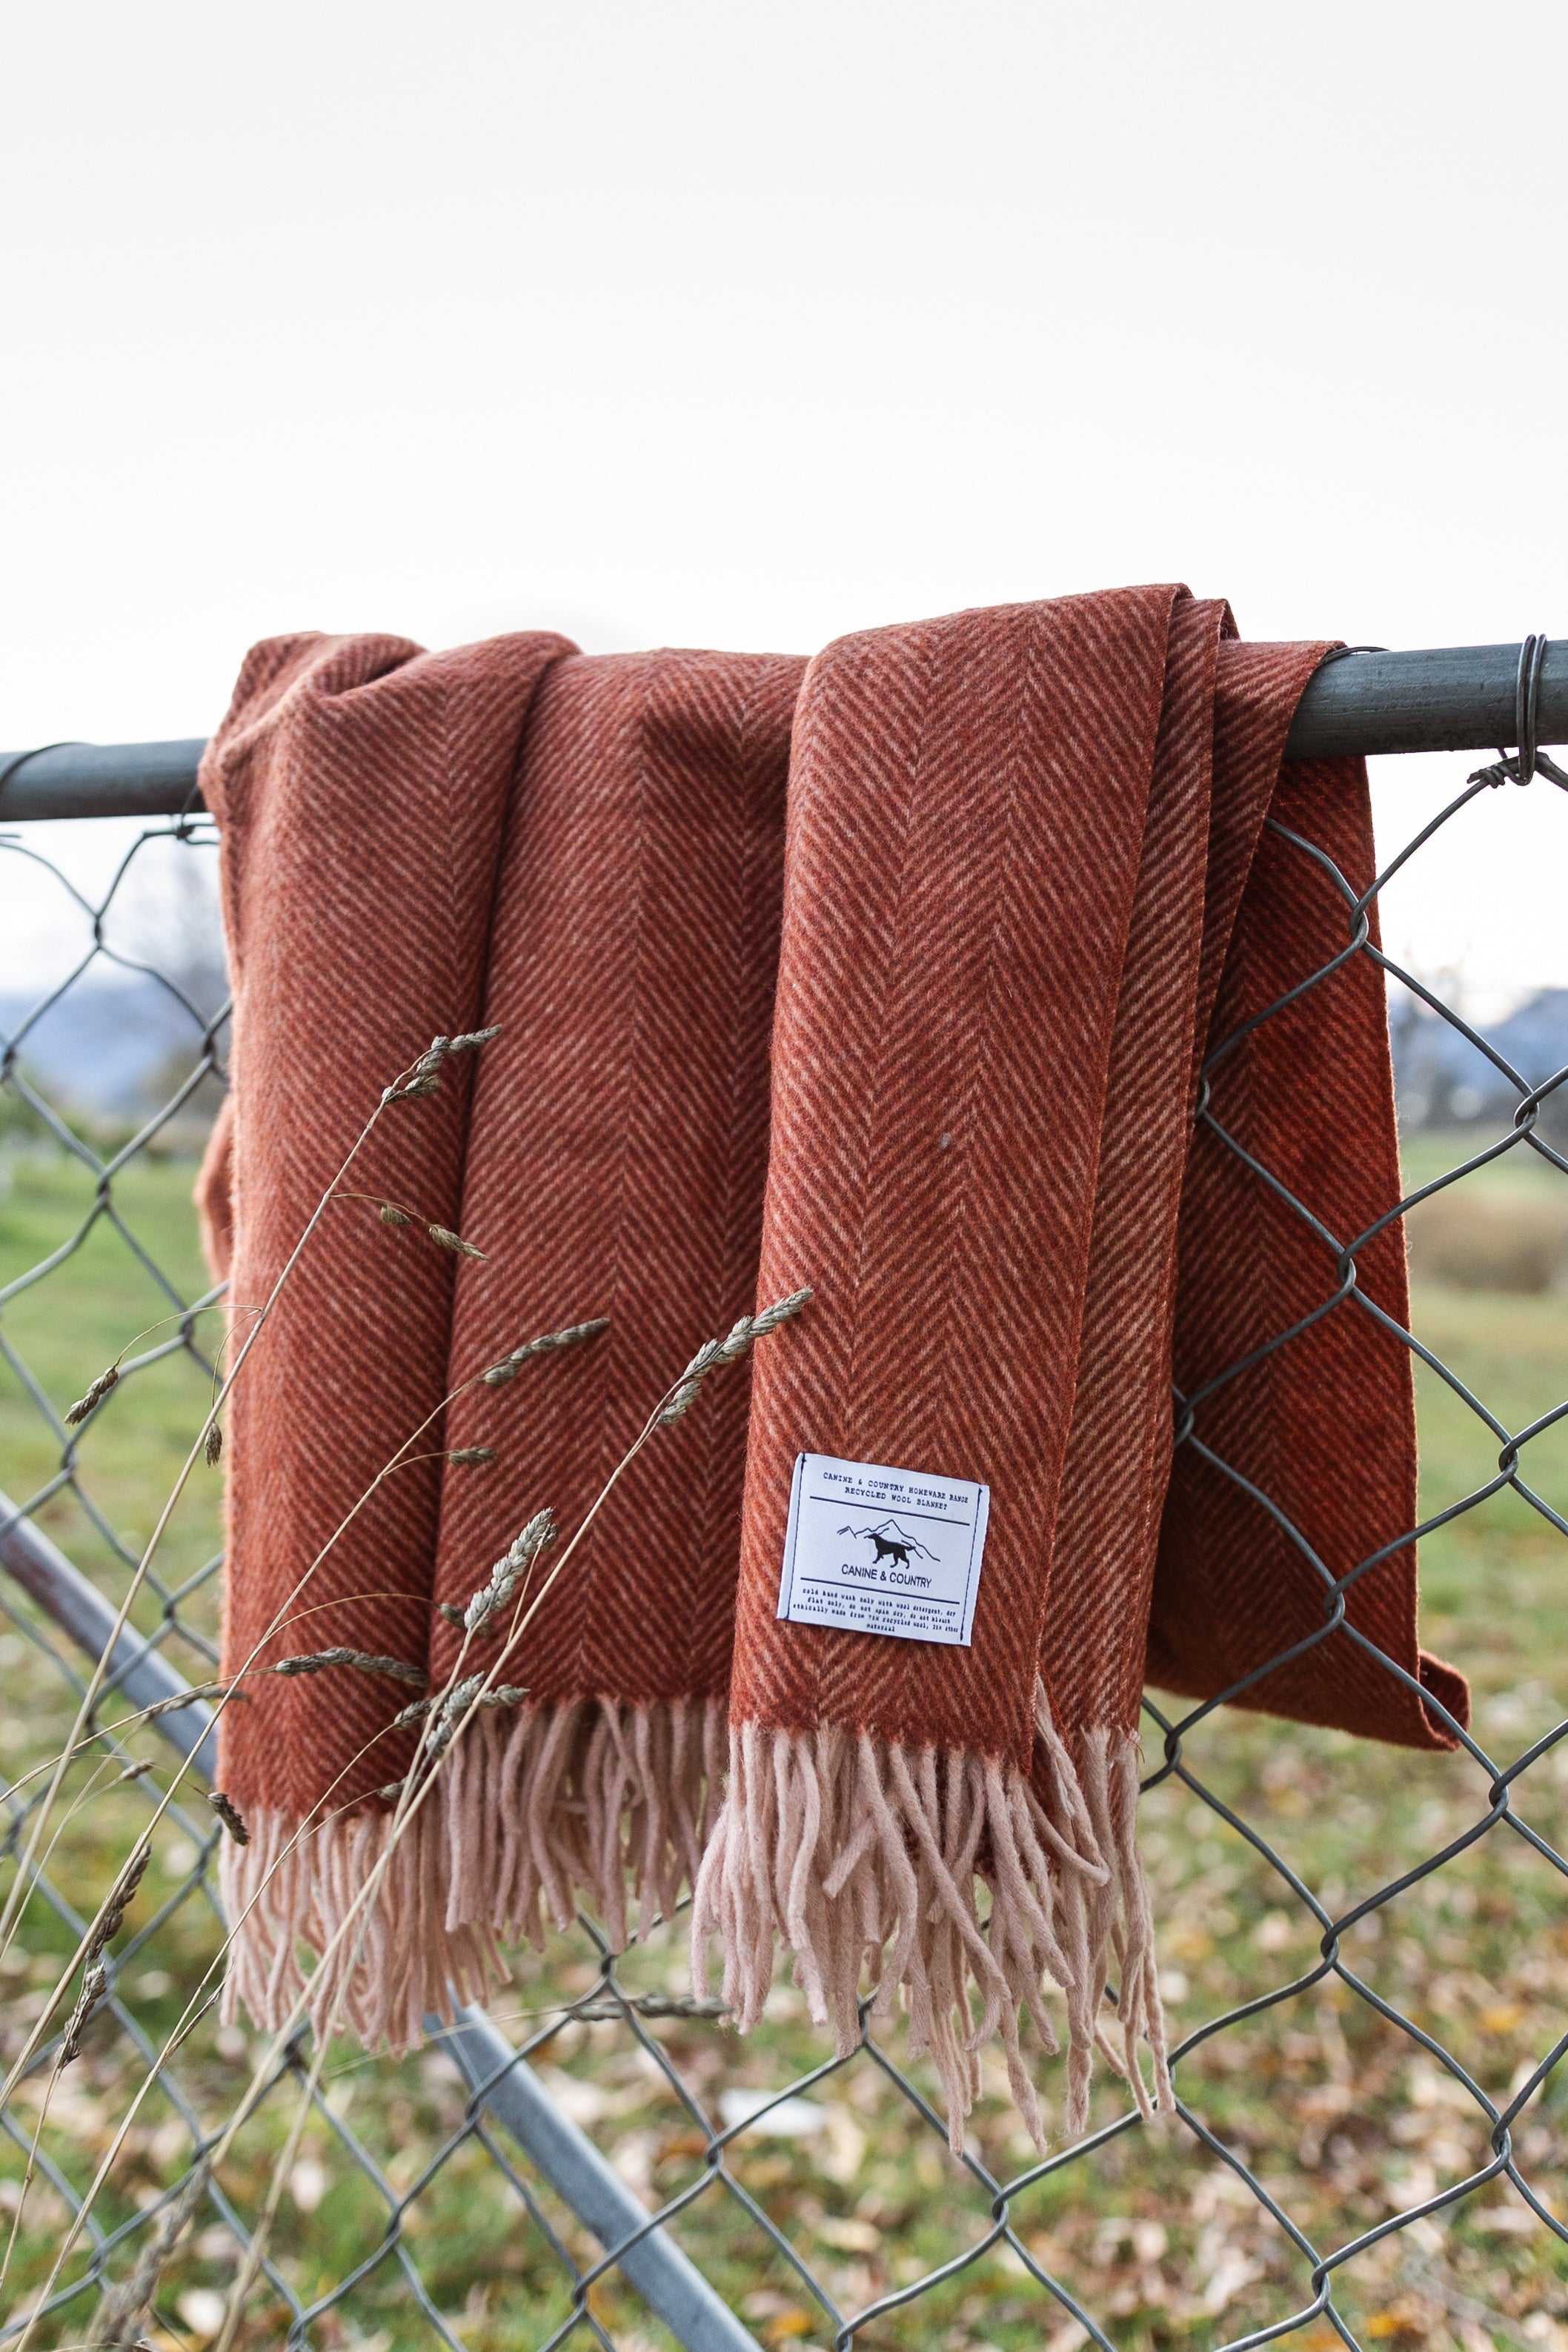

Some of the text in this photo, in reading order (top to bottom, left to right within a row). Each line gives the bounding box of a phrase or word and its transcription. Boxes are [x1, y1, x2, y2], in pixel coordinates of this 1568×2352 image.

[823, 1472, 853, 1484] CANINE
[868, 1480, 904, 1492] COUNTRY
[908, 1486, 946, 1499] HOMEWARE
[949, 1494, 969, 1504] RANGE
[845, 1486, 948, 1510] RECYCLED WOOL BLANKET
[841, 1564, 932, 1588] CANINE & COUNTRY
